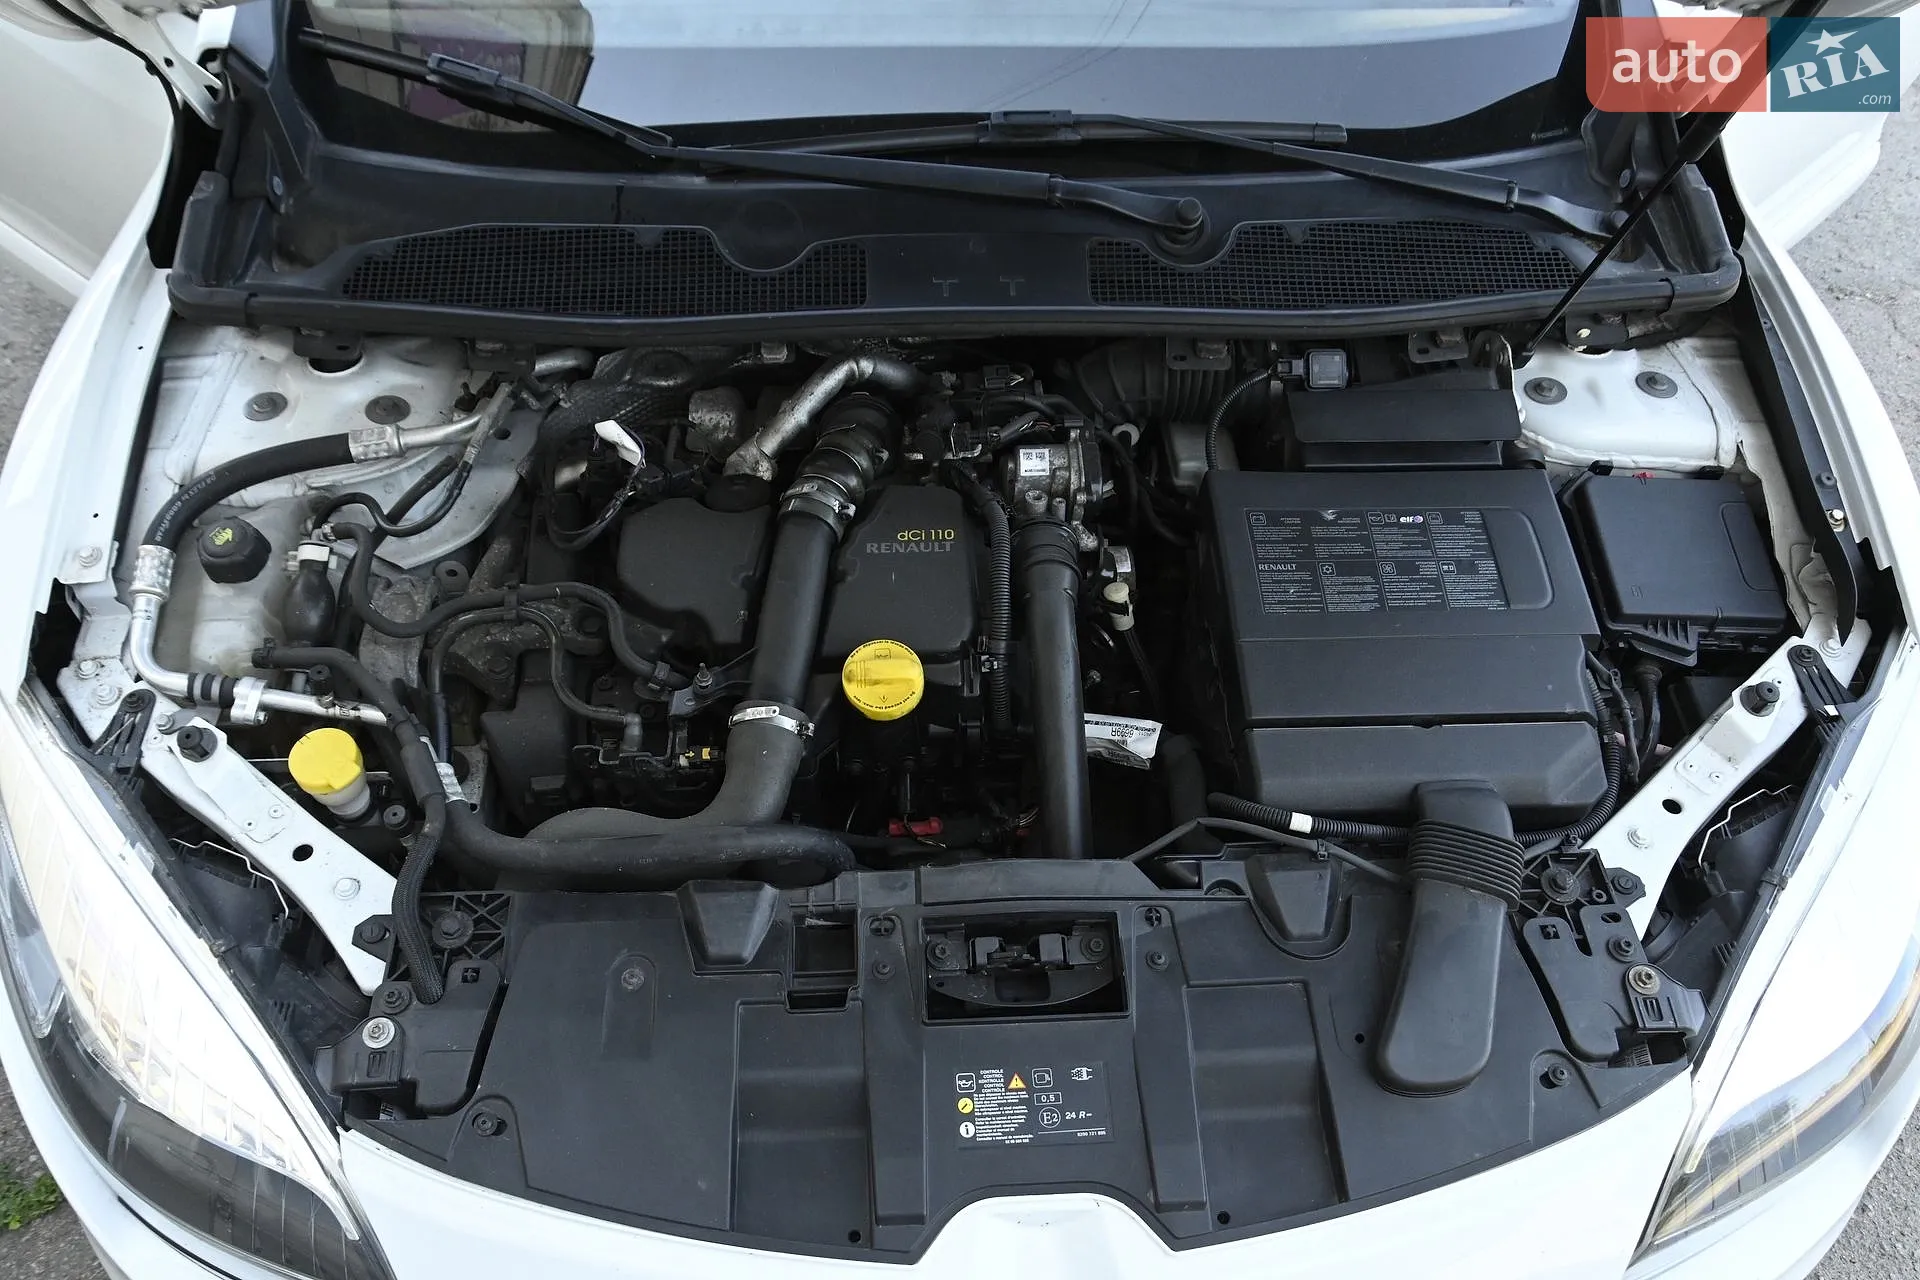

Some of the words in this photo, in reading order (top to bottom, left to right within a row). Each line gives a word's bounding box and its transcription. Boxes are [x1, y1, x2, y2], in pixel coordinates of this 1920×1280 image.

[1400, 515, 1414, 523] elf
[897, 530, 925, 541] dCi
[930, 529, 955, 541] 110
[866, 541, 956, 554] RENAULT
[1258, 563, 1297, 571] RENAULT
[1042, 1111, 1059, 1124] E2
[1065, 1111, 1077, 1120] 24
